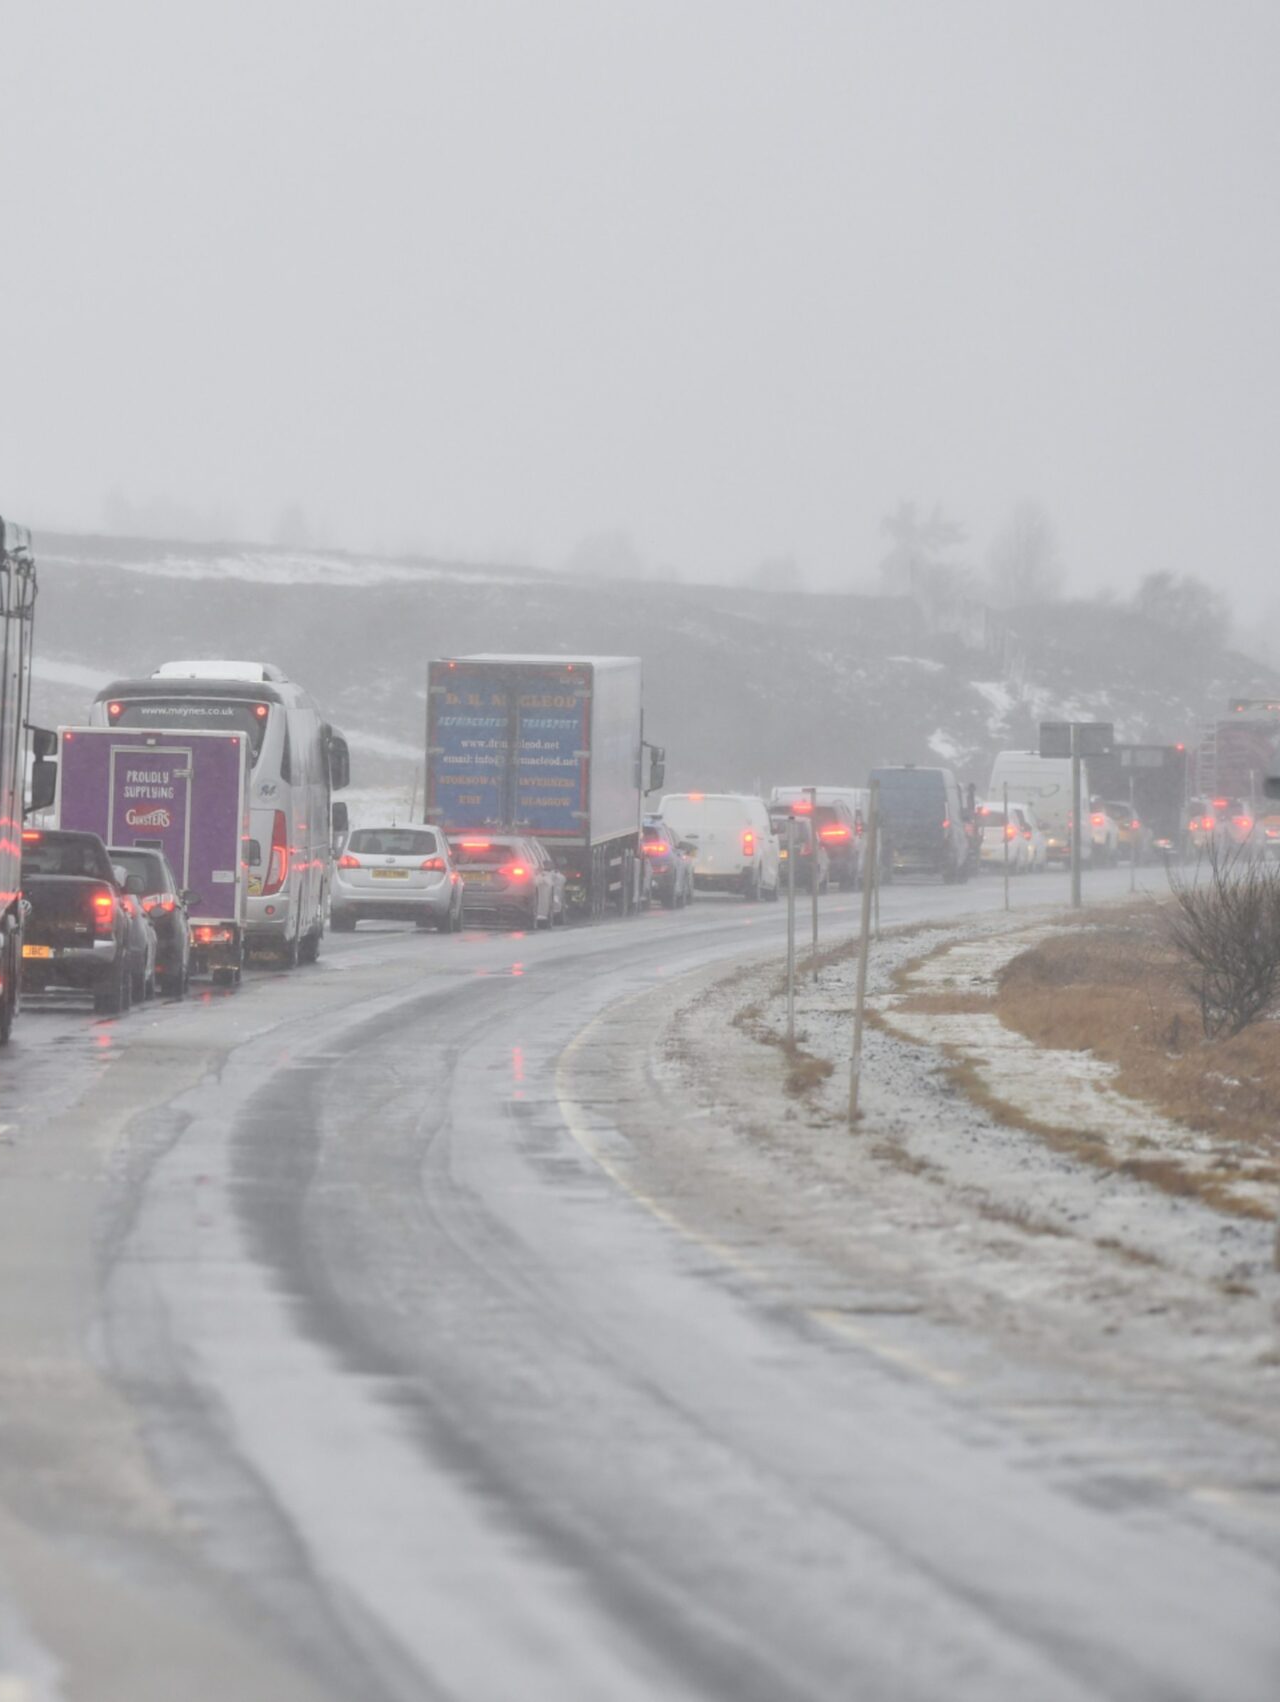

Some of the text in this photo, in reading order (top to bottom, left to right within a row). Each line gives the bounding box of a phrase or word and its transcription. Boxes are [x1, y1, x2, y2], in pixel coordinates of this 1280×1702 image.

[140, 706, 235, 717] www.maynes.co.uk
[522, 718, 579, 729] TRANSPORT
[461, 738, 560, 750] www.drmcleod.net
[443, 754, 474, 765] email:
[126, 769, 169, 784] PROUDLY
[519, 777, 576, 788] INVERNESS
